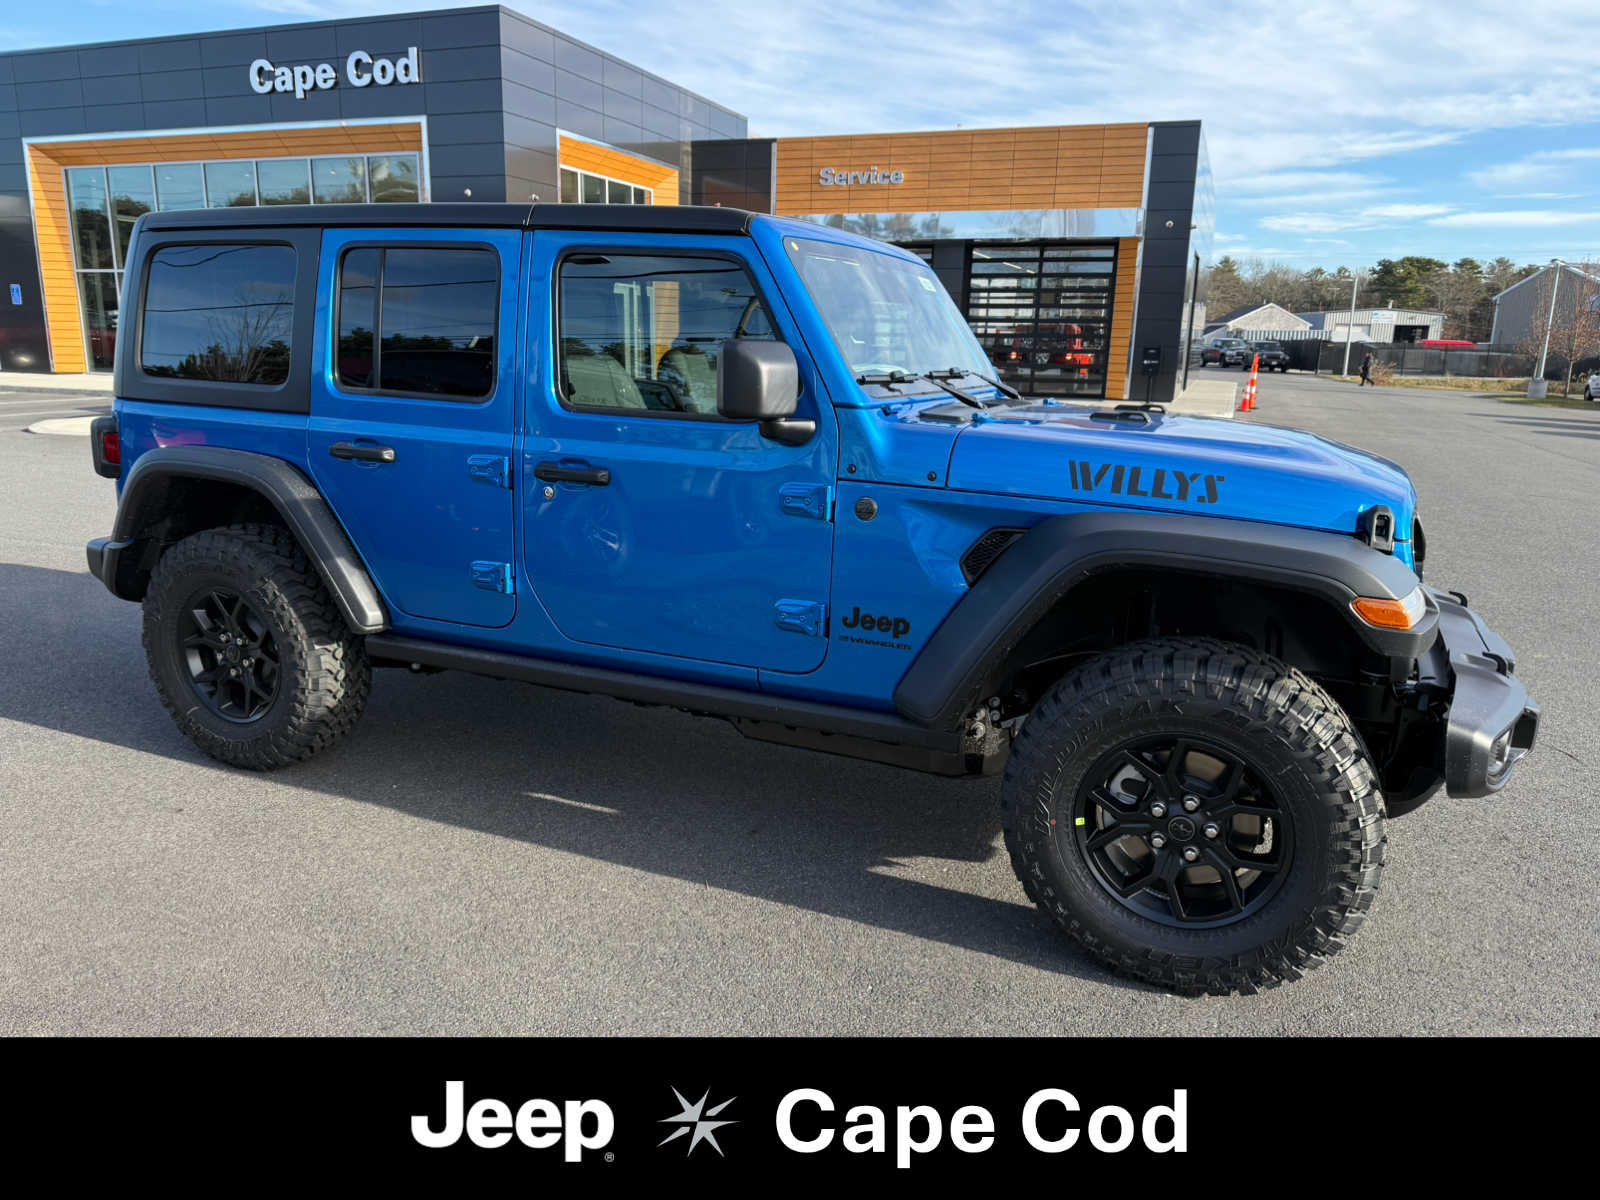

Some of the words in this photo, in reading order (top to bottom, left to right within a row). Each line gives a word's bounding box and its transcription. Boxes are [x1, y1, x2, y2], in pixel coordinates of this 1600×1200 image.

[250, 59, 337, 99] Cape
[347, 46, 421, 87] Cod
[819, 165, 904, 186] Service
[1069, 460, 1225, 504] WILLYS
[842, 606, 910, 639] Jeep
